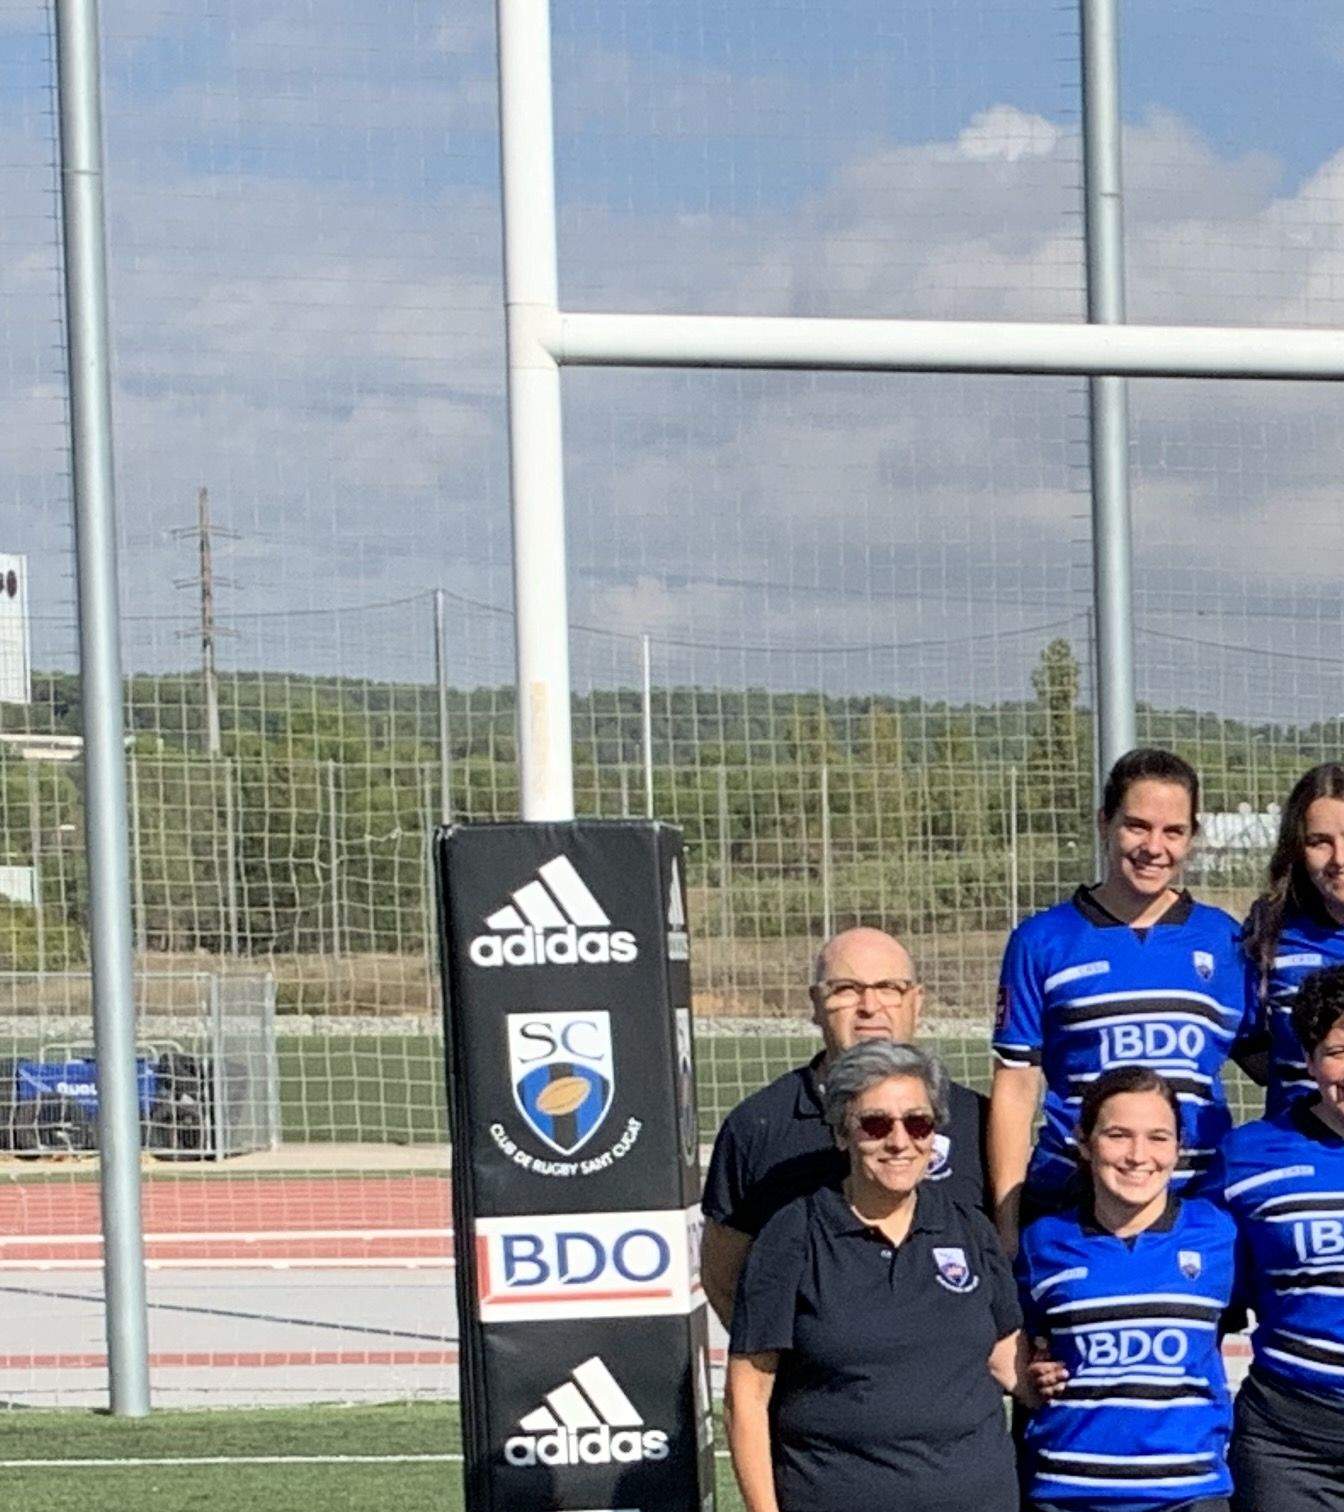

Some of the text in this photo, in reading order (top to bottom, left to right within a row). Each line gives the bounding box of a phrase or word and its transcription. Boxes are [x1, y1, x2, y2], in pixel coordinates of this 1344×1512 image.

[469, 924, 638, 967] adidas
[519, 1021, 605, 1063] SC
[1114, 1023, 1205, 1059] BDO
[490, 1123, 517, 1155] CLUB
[513, 1151, 533, 1168] DE
[532, 1159, 578, 1177] RUGBY
[581, 1151, 613, 1174] SANT
[501, 1229, 671, 1286] BDO
[1087, 1329, 1187, 1365] BDO
[505, 1423, 670, 1466] adidas
